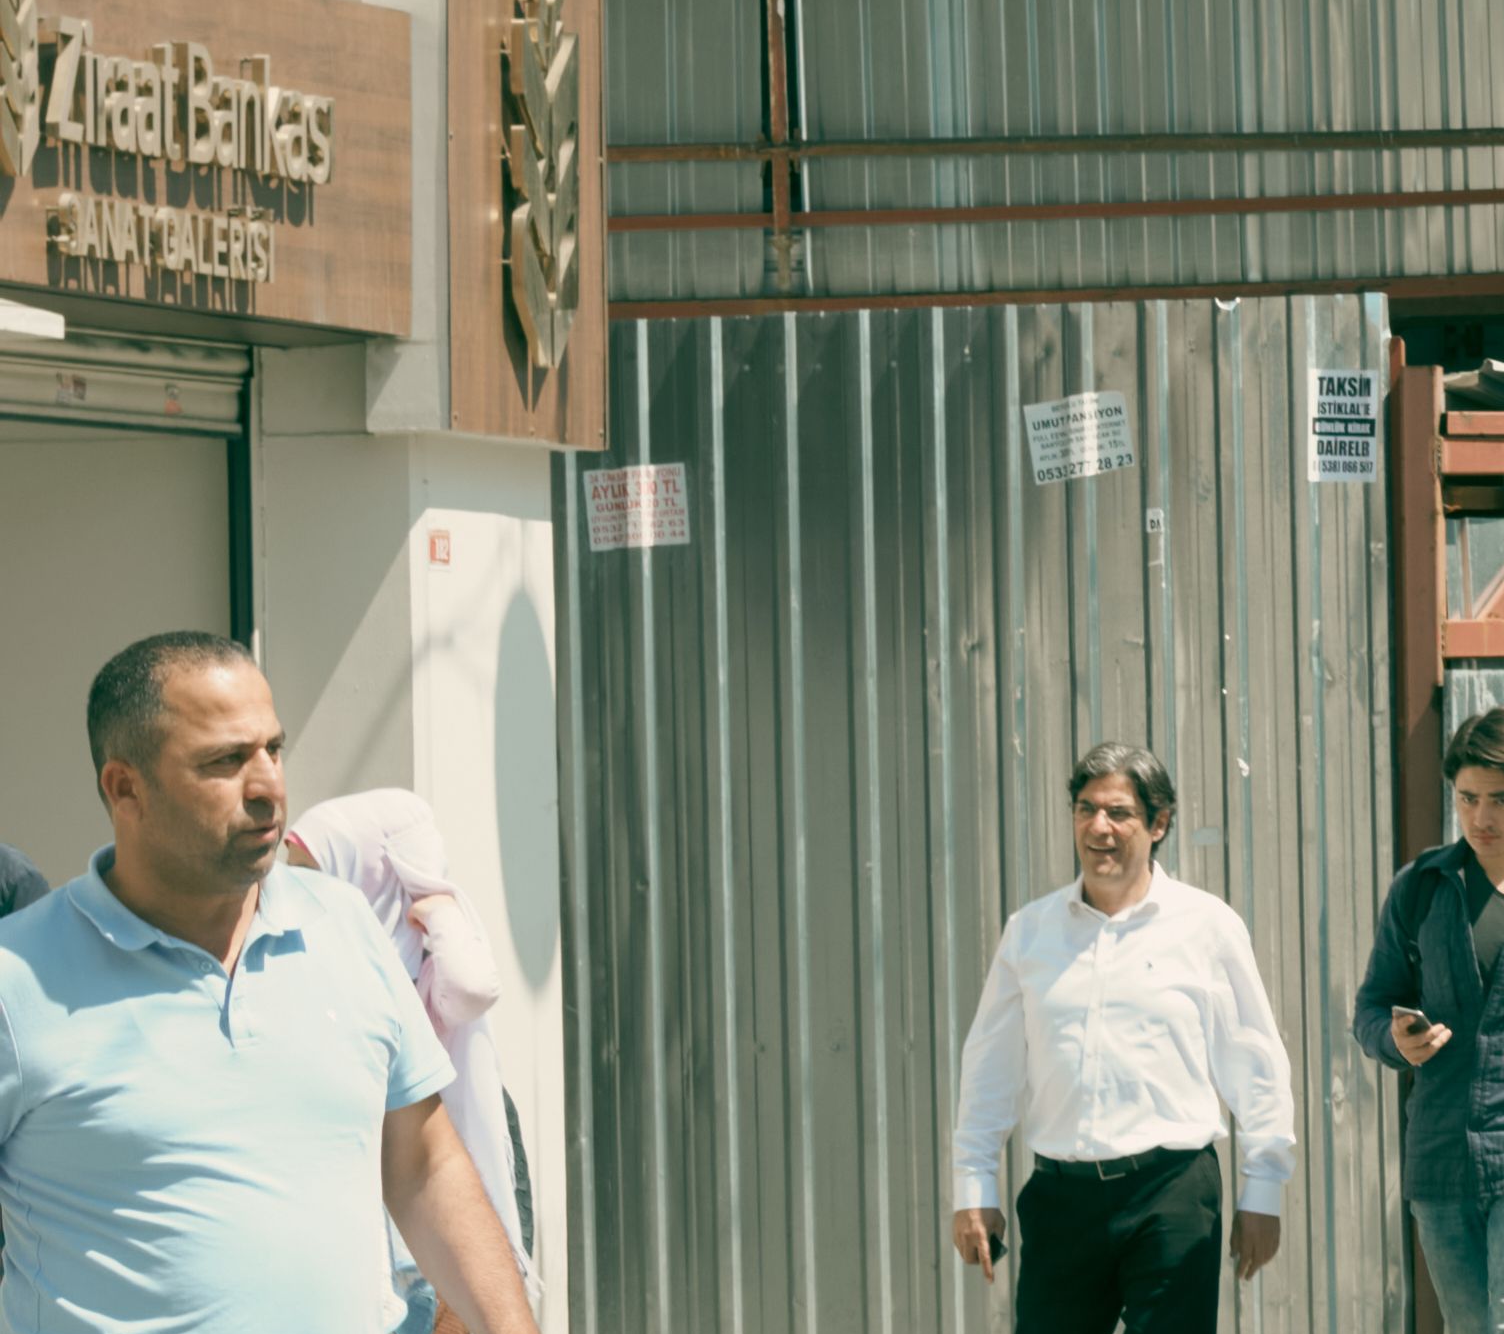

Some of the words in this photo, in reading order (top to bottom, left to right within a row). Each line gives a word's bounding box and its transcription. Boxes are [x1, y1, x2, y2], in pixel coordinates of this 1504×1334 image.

[46, 17, 181, 162] Ziraat
[58, 193, 156, 267] SANAT
[662, 478, 681, 495] TL
